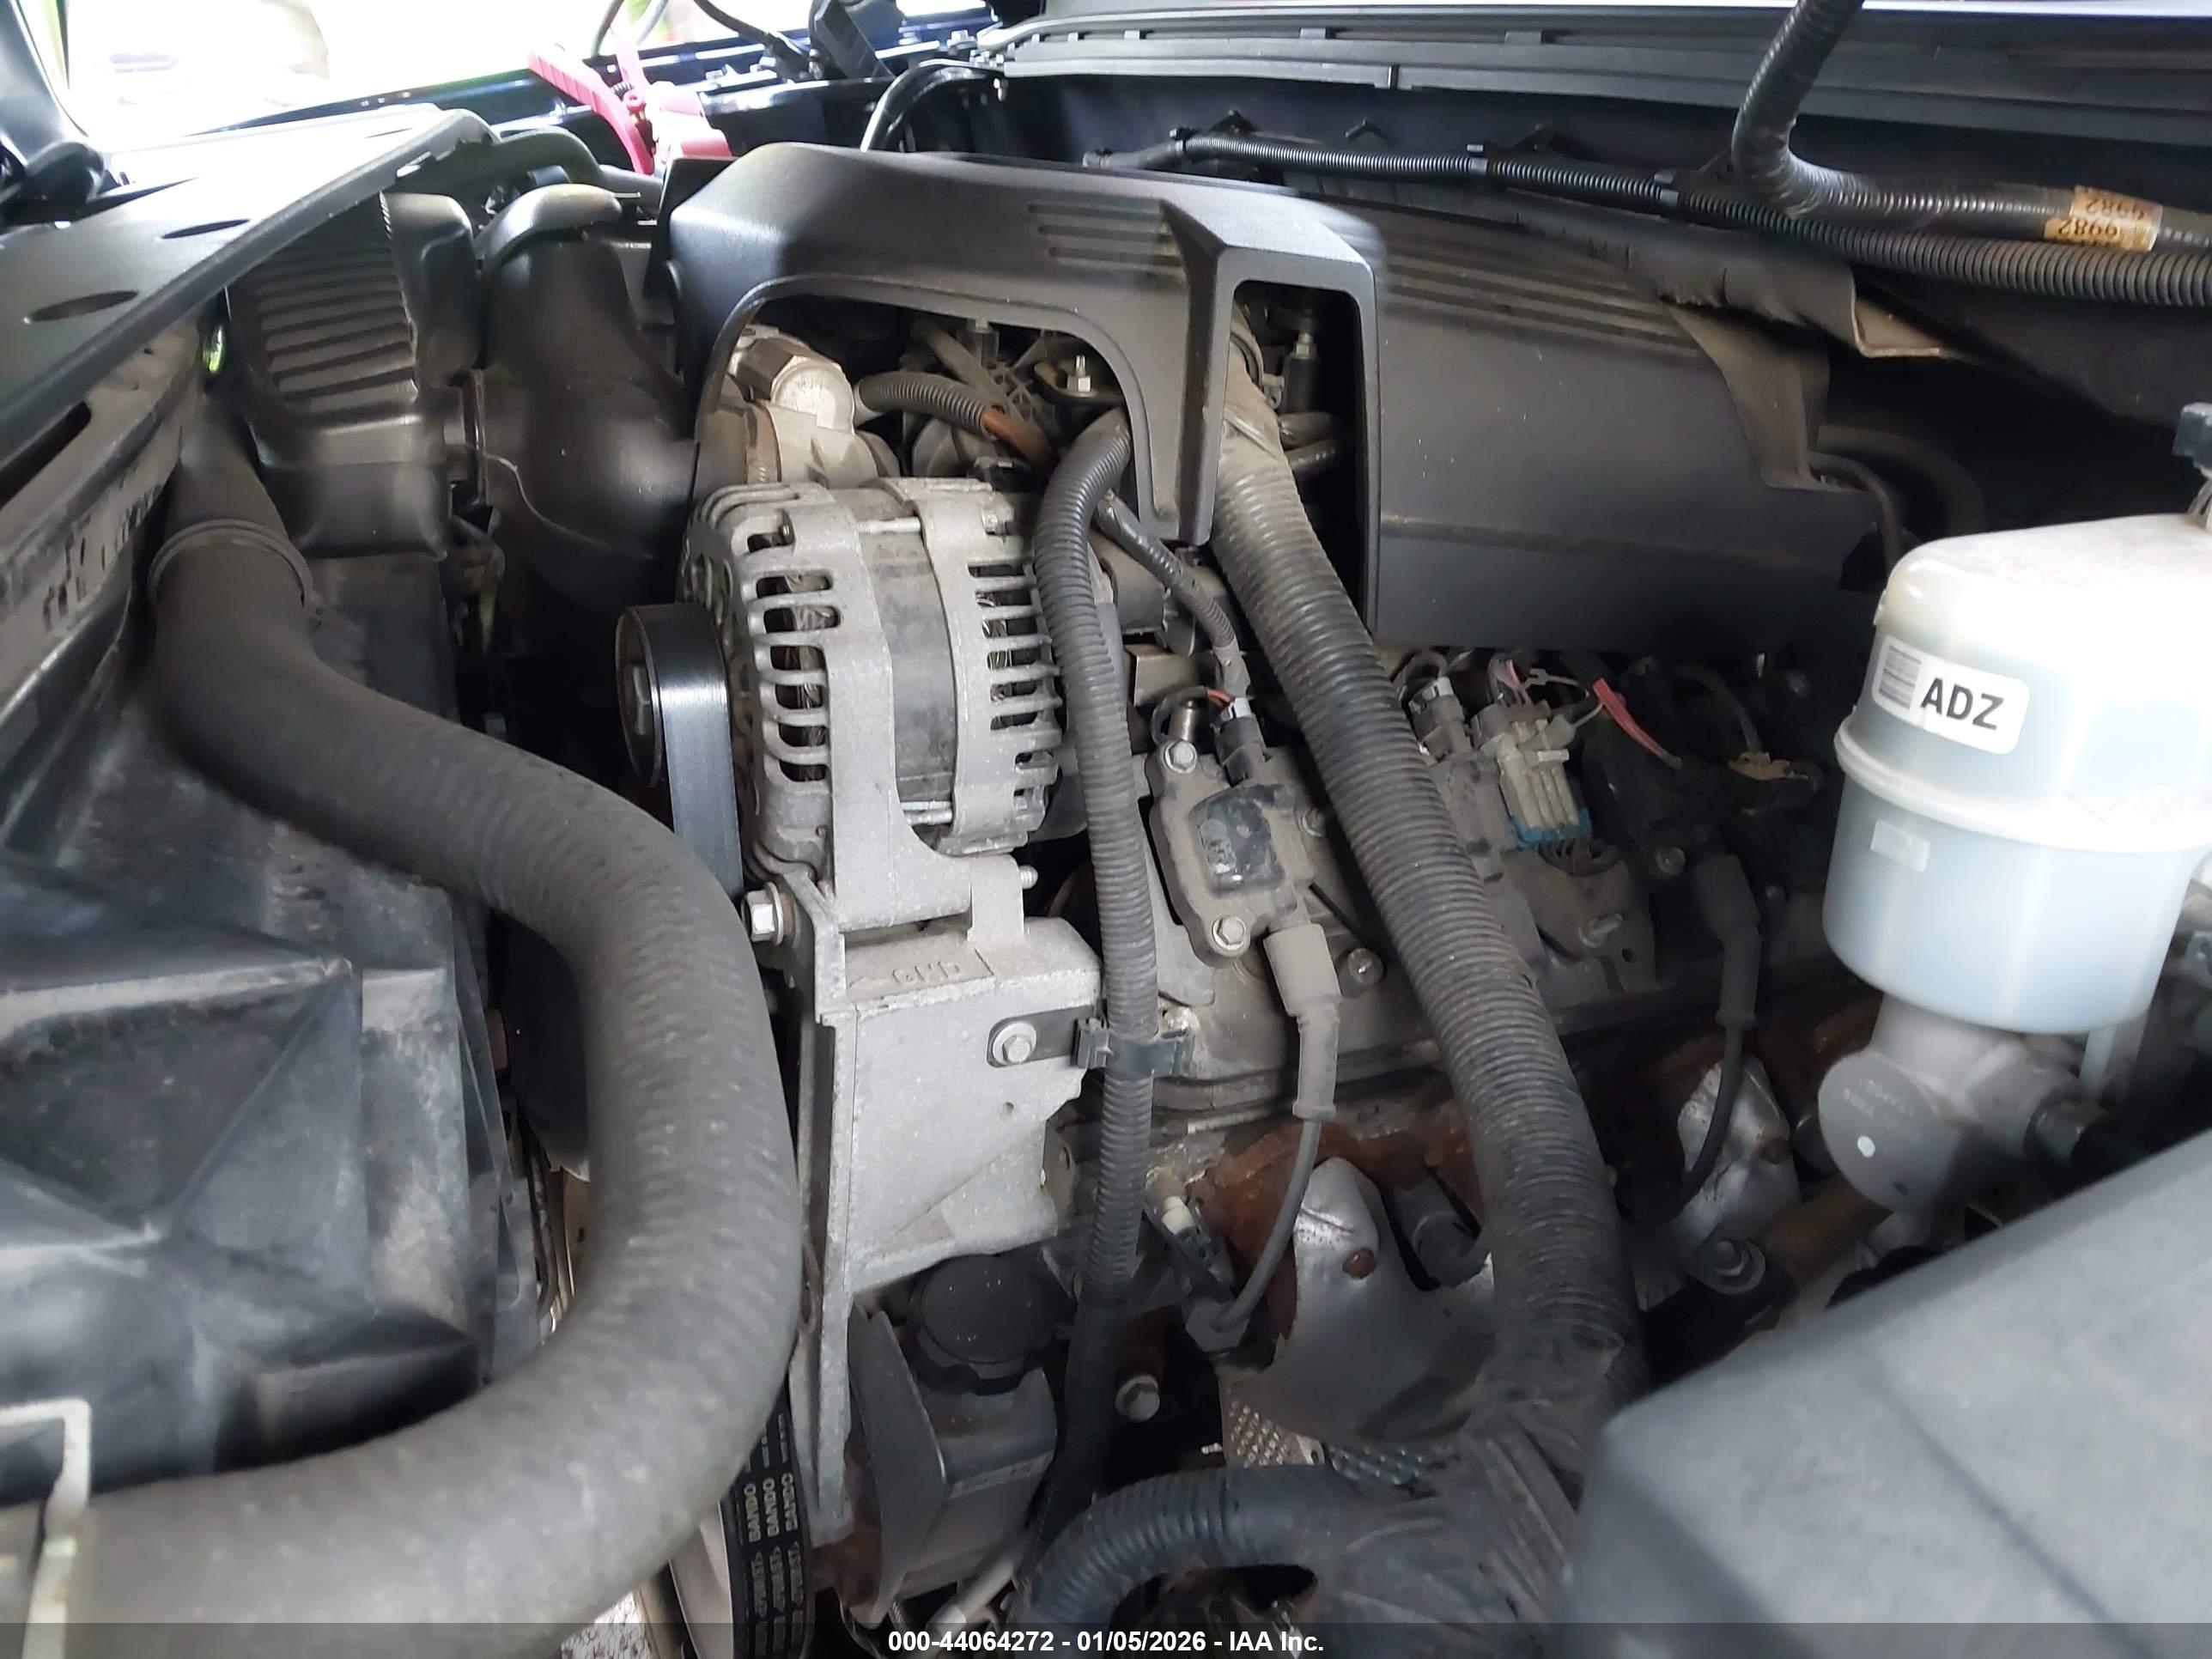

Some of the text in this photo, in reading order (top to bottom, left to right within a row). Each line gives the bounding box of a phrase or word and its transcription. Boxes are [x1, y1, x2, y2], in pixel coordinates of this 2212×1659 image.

[1920, 677, 2004, 730] ADZ
[744, 1483, 762, 1543] BANDO
[763, 1477, 780, 1538] BANDO
[781, 1473, 799, 1532] BANDO
